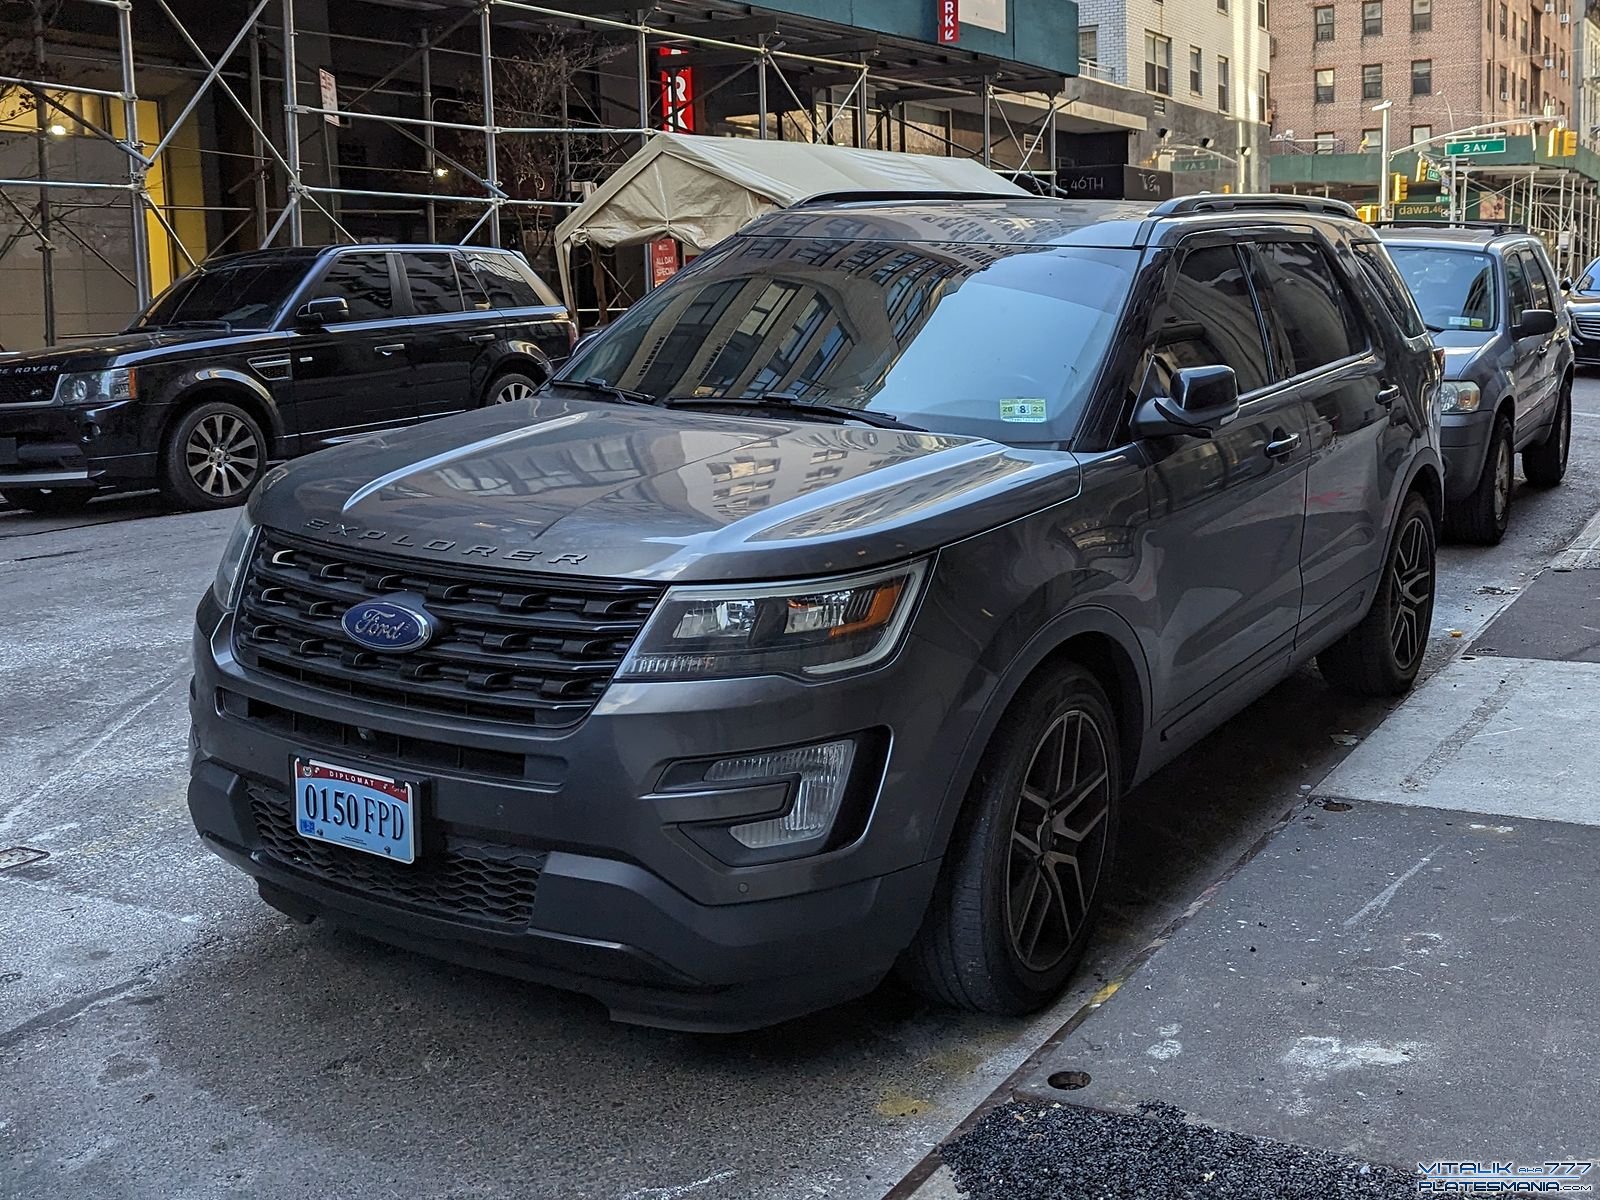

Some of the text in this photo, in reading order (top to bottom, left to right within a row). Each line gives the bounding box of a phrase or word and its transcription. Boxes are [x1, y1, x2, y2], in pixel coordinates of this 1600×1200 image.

[1463, 143, 1488, 152] 2 Av
[1071, 176, 1104, 191] 46TH
[664, 256, 674, 265] DAY
[15, 364, 58, 375] ROVER
[1019, 405, 1026, 414] 8
[304, 518, 588, 565] EXPLORER
[354, 608, 402, 641] Ford
[329, 770, 375, 787] DIPLOMAT
